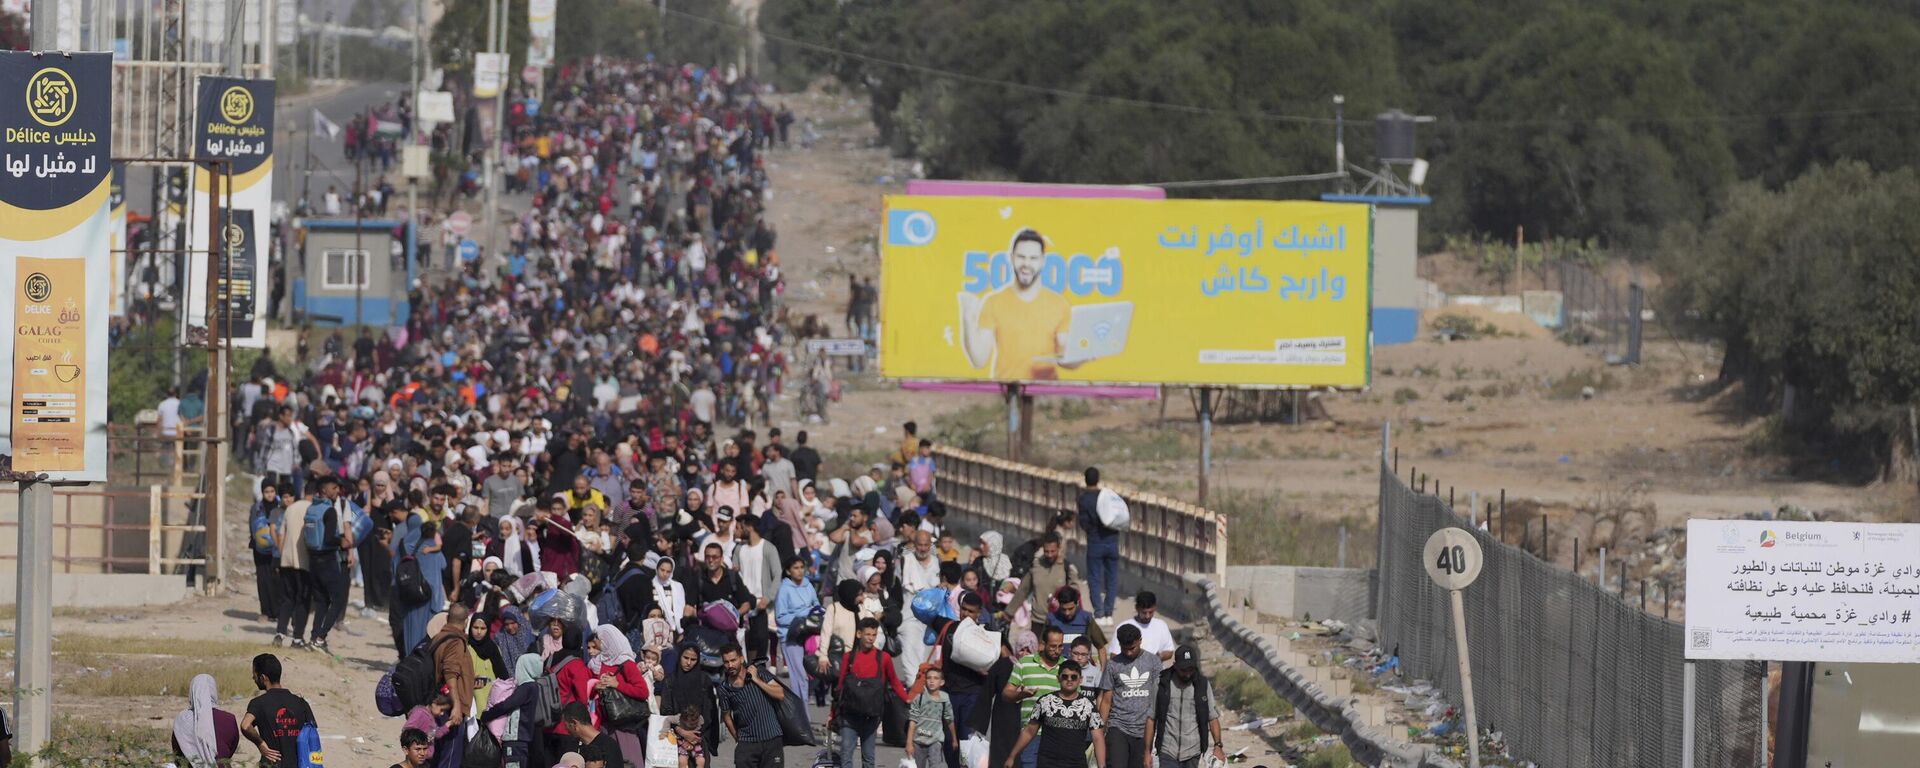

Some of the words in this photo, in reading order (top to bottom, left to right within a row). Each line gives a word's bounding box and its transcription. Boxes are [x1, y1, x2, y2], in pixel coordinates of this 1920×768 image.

[6, 127, 50, 143] Délice
[207, 123, 236, 134] Délice
[237, 125, 265, 136] ديليس
[54, 128, 96, 146] ديليس
[207, 139, 223, 155] لها
[225, 139, 252, 157] مثيل
[254, 141, 265, 155] لا
[6, 153, 30, 178] لها
[35, 152, 77, 178] مثيل
[81, 155, 96, 174] لا
[1158, 225, 1198, 248] نت
[1205, 217, 1264, 256] أوفر
[1273, 224, 1346, 257] اشبك
[1201, 263, 1270, 297] كاش
[1279, 266, 1346, 300] واربح
[18, 325, 62, 336] GALAG
[1785, 531, 1822, 542] Belgium
[1436, 545, 1466, 575] 40
[1731, 560, 1776, 576] والطيور
[1780, 562, 1822, 576] للنباتات
[1826, 562, 1860, 577] موطن
[1864, 563, 1886, 578] غزة
[1727, 579, 1763, 592] نظافته
[1802, 582, 1826, 597] عليه
[1831, 581, 1874, 595] فلنحافظ
[1901, 610, 1912, 623] #
[1121, 689, 1149, 698] adidas
